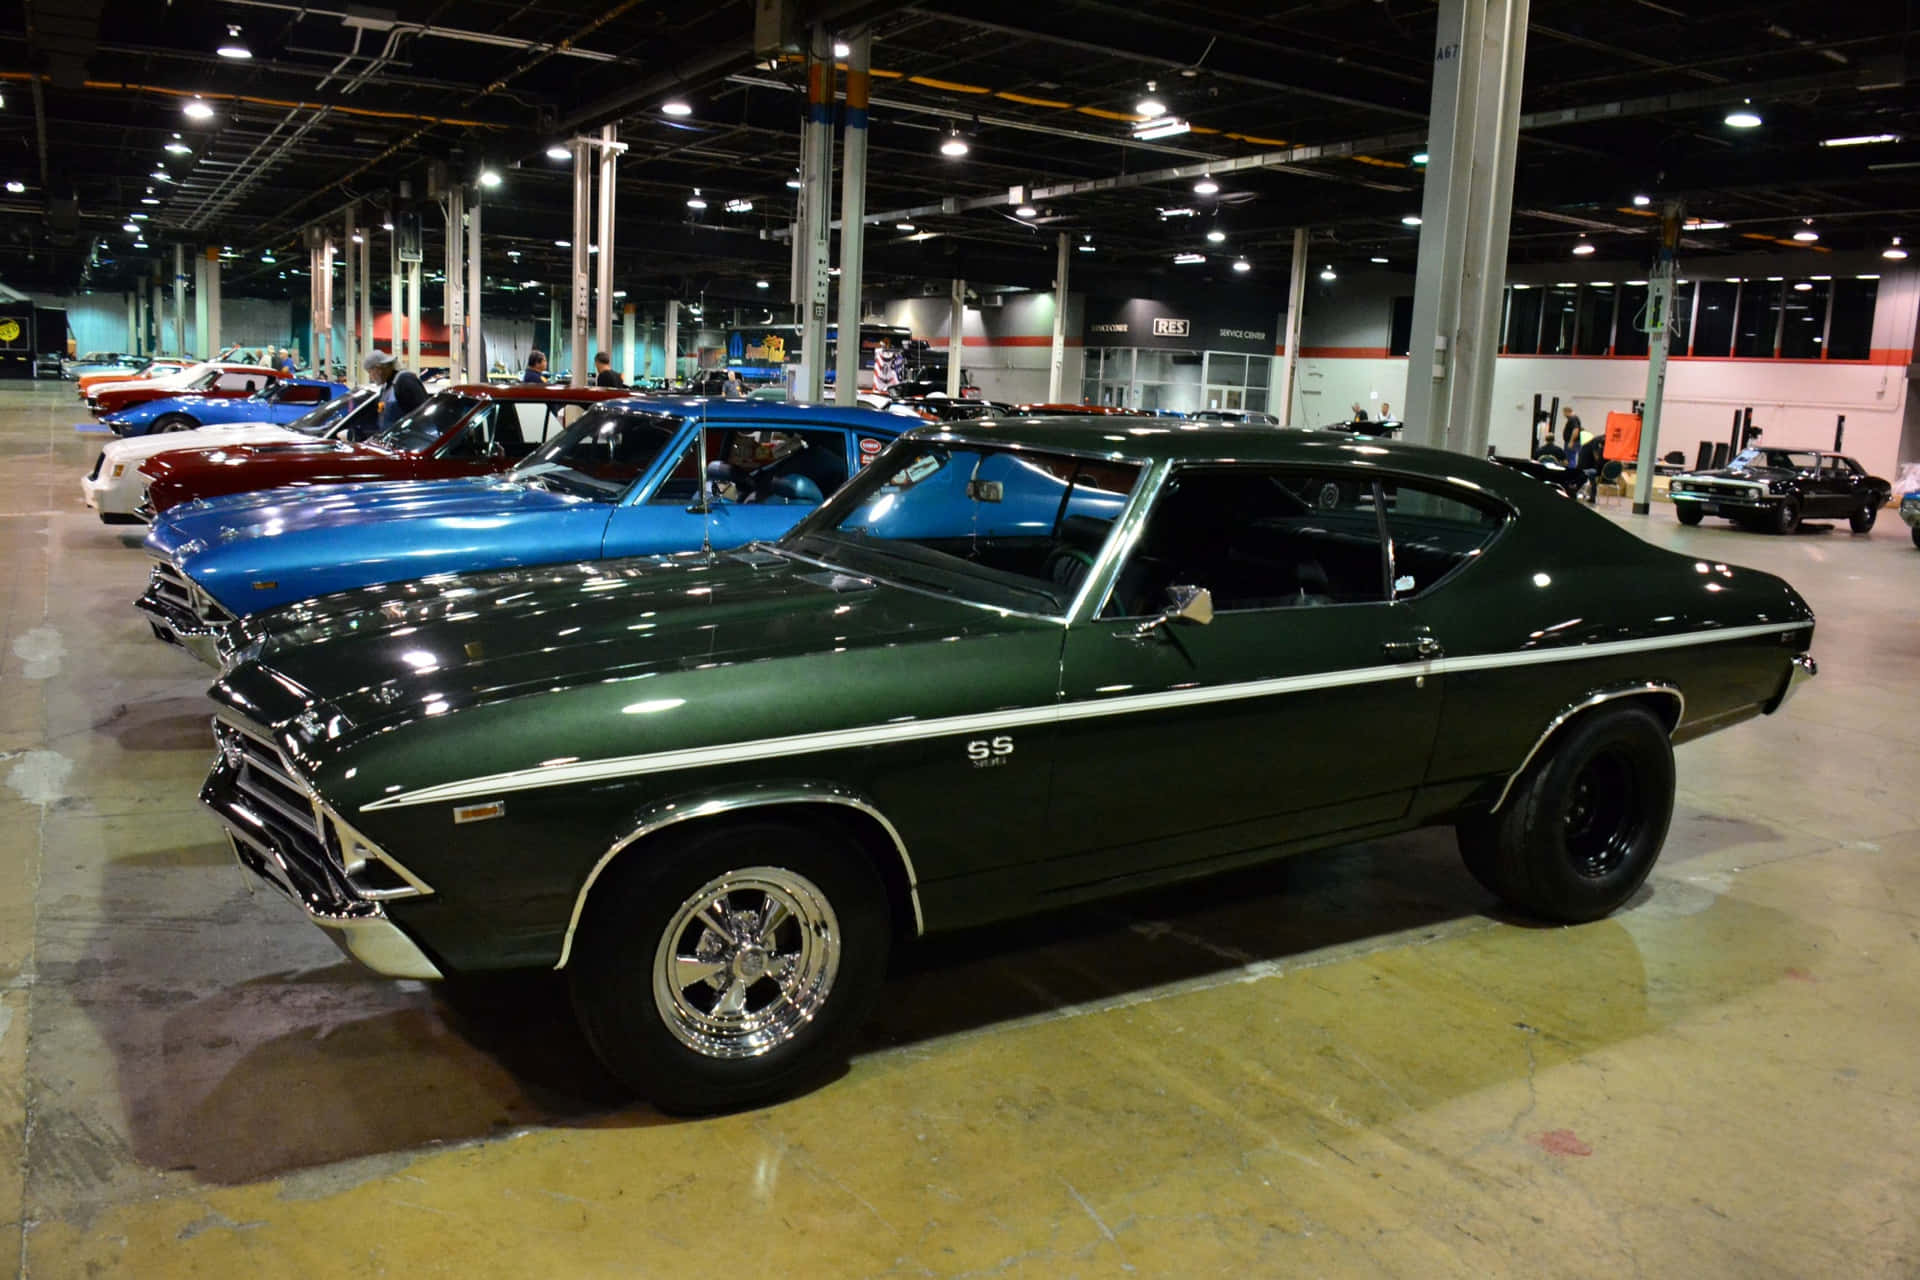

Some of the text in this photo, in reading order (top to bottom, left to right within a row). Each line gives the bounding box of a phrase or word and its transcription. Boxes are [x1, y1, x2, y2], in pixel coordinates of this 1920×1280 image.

[1437, 45, 1458, 60] A67
[1157, 320, 1185, 334] RES
[1219, 328, 1266, 340] SERVICE CENTER
[968, 736, 1014, 760] SS
